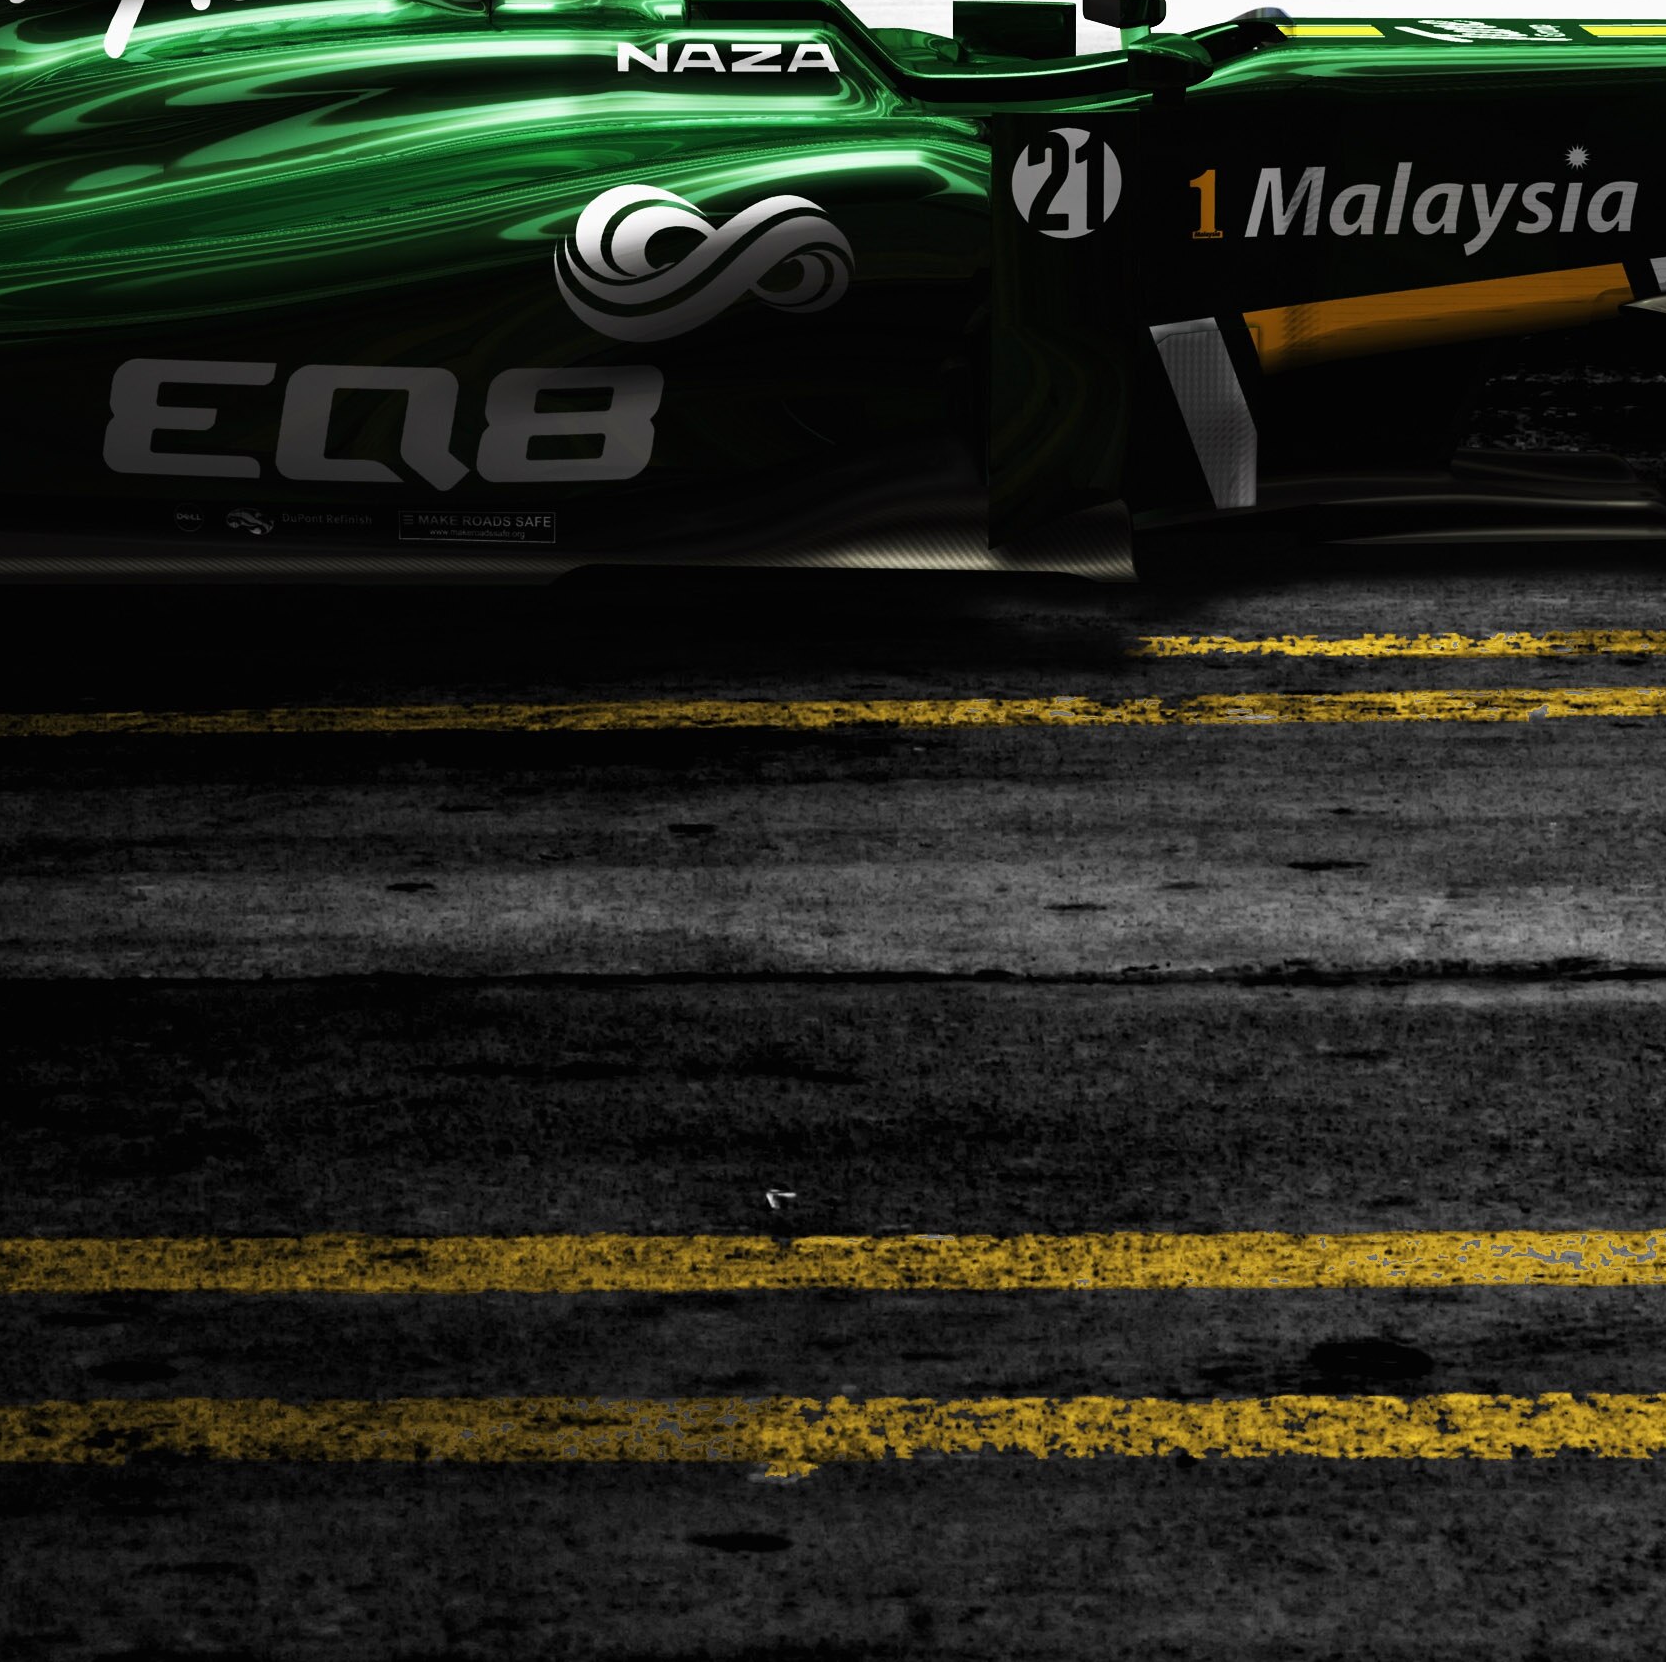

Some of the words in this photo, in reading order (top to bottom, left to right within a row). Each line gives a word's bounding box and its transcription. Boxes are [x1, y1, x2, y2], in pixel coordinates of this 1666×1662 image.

[617, 43, 841, 73] NAZA
[1025, 133, 1106, 235] 21
[1244, 143, 1639, 256] Malaysia
[102, 357, 665, 492] EQ8
[176, 513, 202, 521] DELL
[283, 513, 322, 523] DuPont
[418, 515, 460, 526] MAKE
[462, 516, 511, 528] ROADS
[515, 516, 552, 528] SAFE
